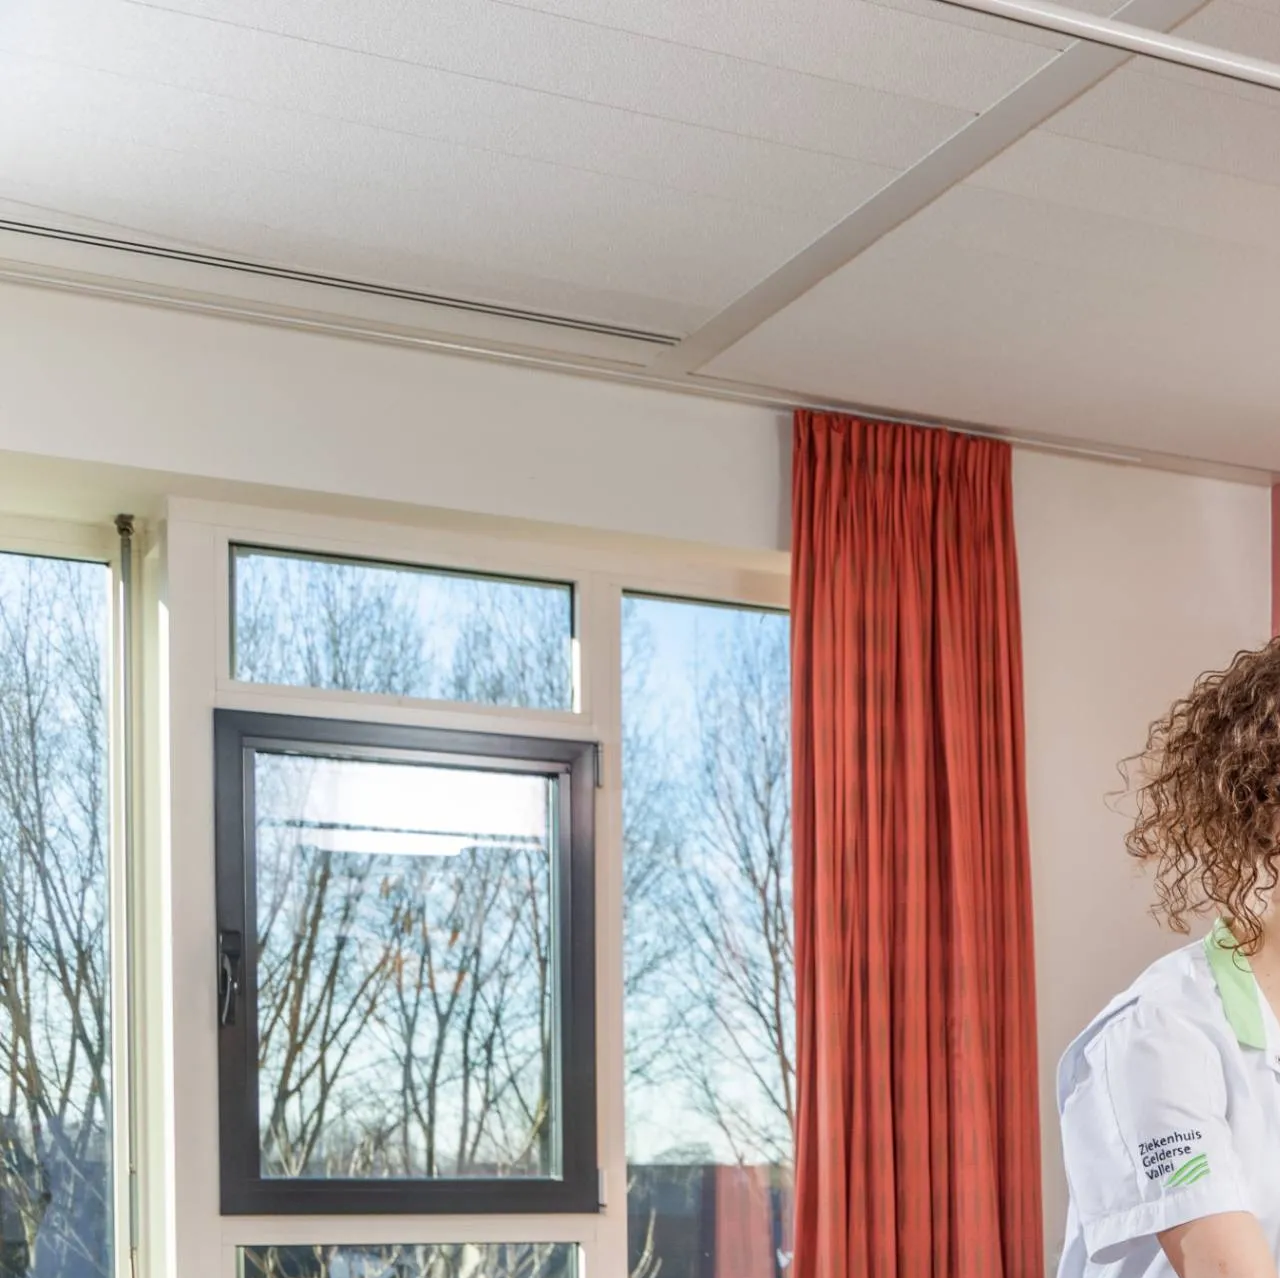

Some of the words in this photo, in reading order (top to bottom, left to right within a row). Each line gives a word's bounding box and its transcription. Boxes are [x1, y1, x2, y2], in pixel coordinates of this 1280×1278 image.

[1138, 1129, 1202, 1156] Ziekenhuis
[1142, 1145, 1191, 1168] Gelderse
[1145, 1159, 1175, 1180] Vallei
